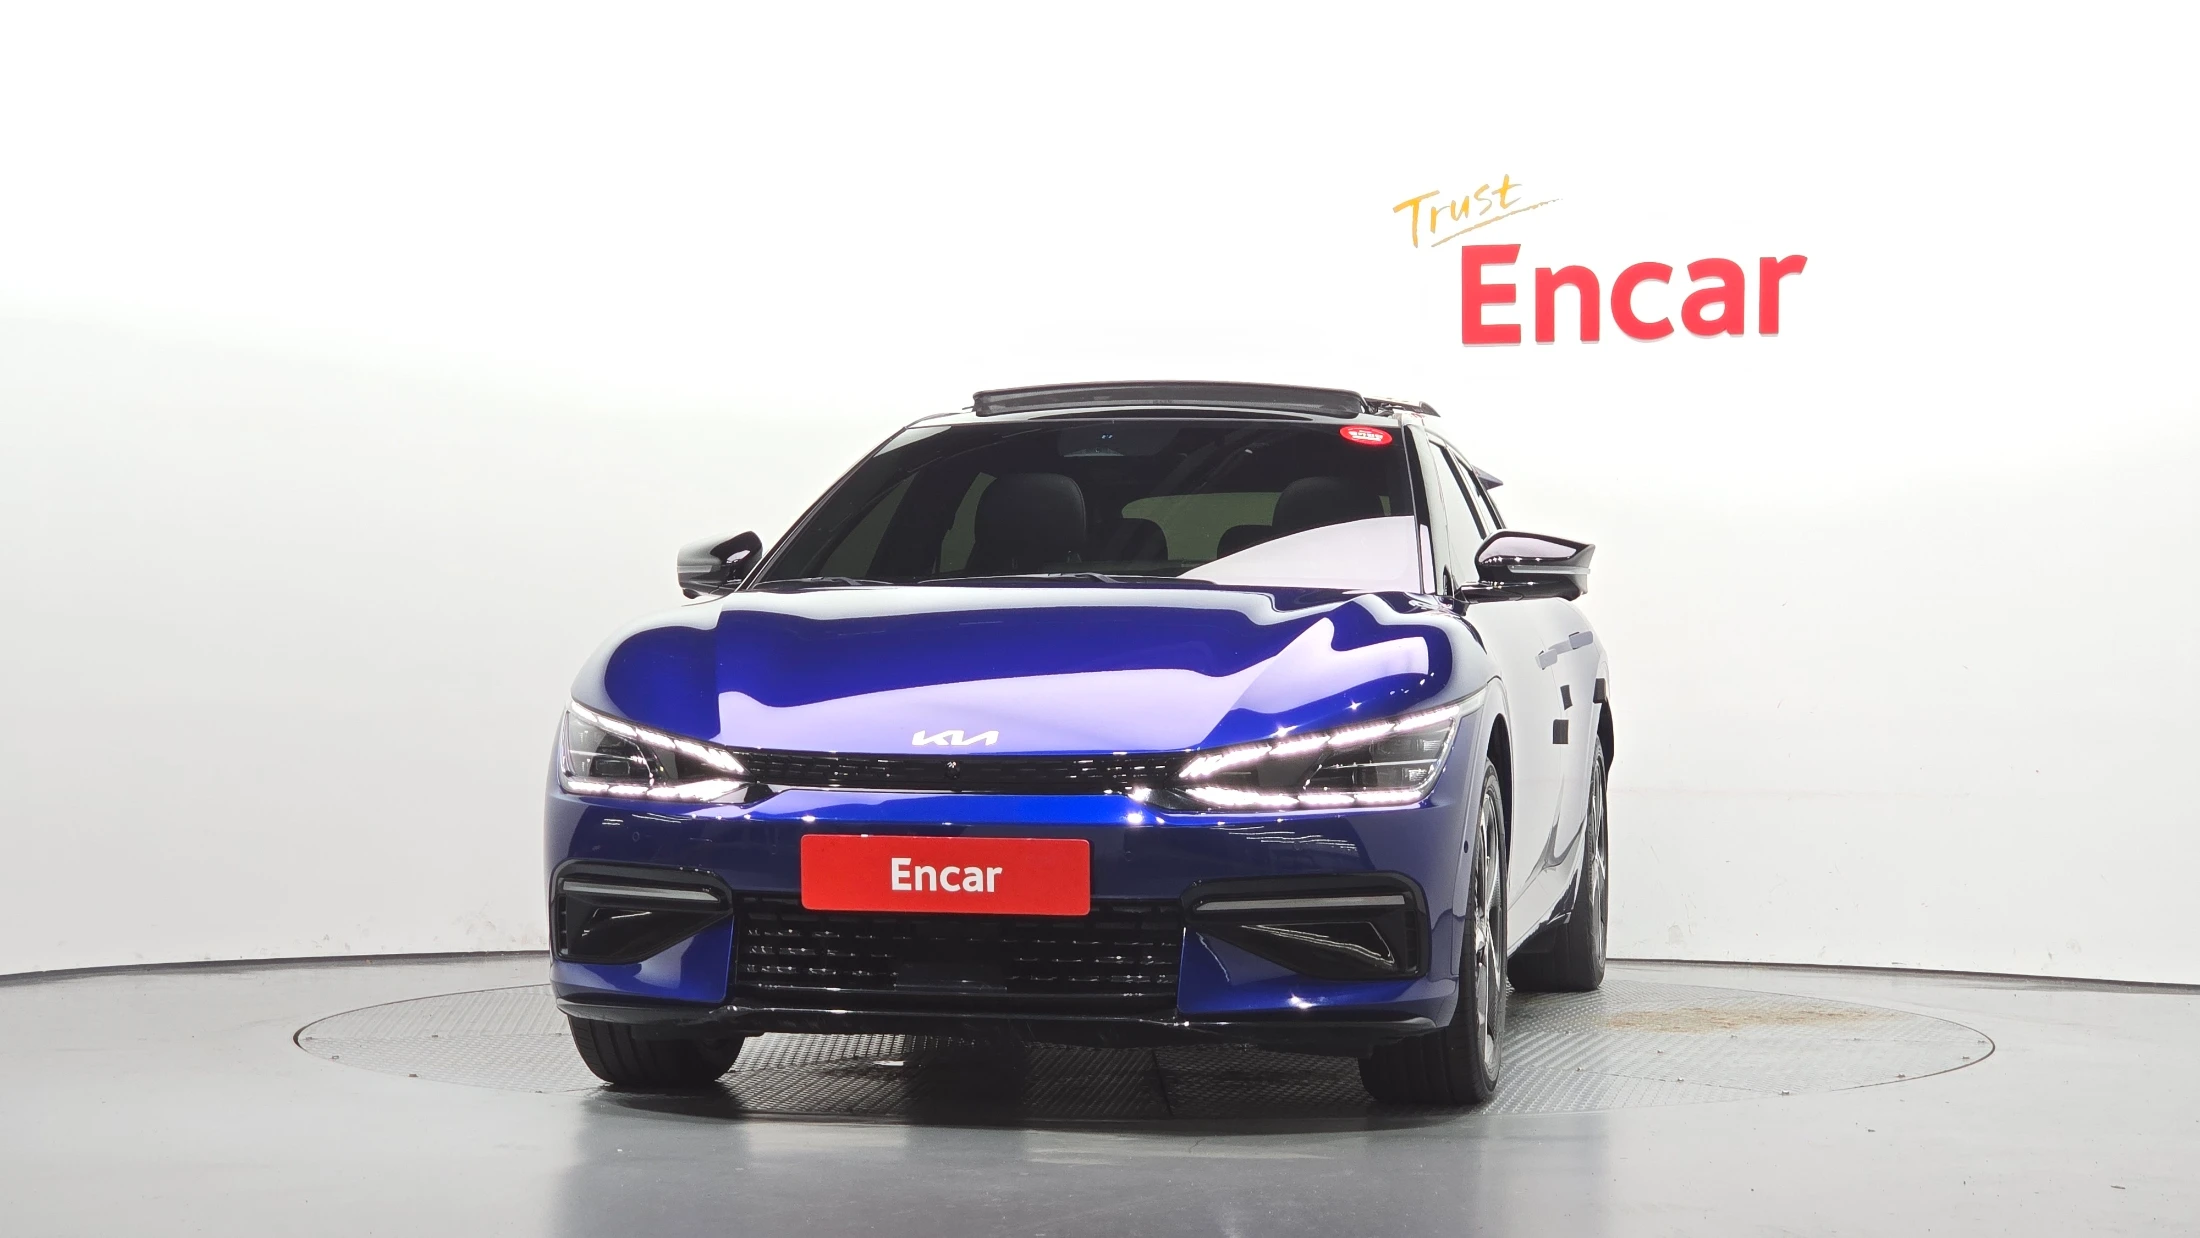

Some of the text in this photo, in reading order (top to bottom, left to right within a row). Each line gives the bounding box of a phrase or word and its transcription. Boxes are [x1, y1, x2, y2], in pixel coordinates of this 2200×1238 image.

[1393, 174, 1523, 248] Trust
[1461, 243, 1808, 347] Encar
[911, 729, 1000, 747] KIA
[891, 857, 1003, 893] Encar
